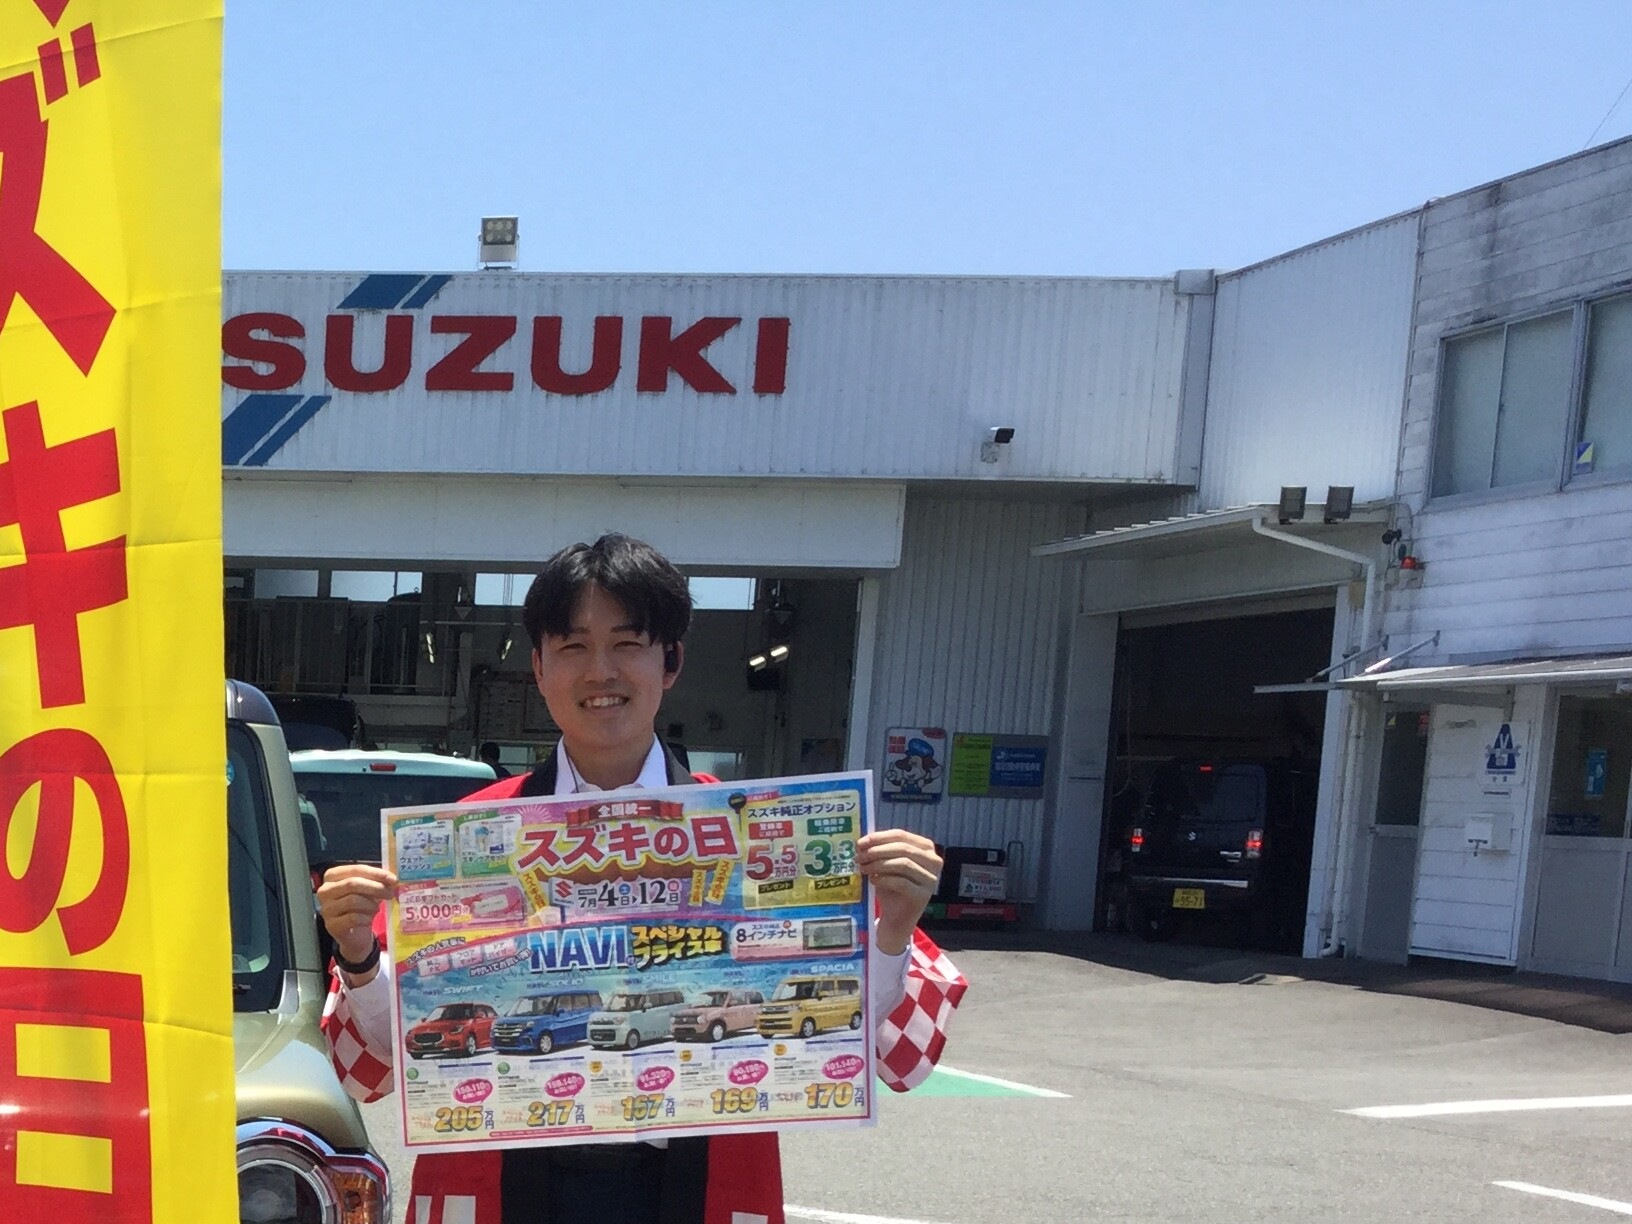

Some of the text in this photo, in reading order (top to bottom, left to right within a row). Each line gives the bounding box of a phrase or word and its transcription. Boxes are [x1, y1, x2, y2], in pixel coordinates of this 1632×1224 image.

[221, 312, 791, 395] SUZUKI
[598, 803, 652, 817] 全国統一
[517, 815, 739, 869] スズキの日
[527, 925, 629, 972] NAVI
[736, 927, 798, 943] 8インチナビ
